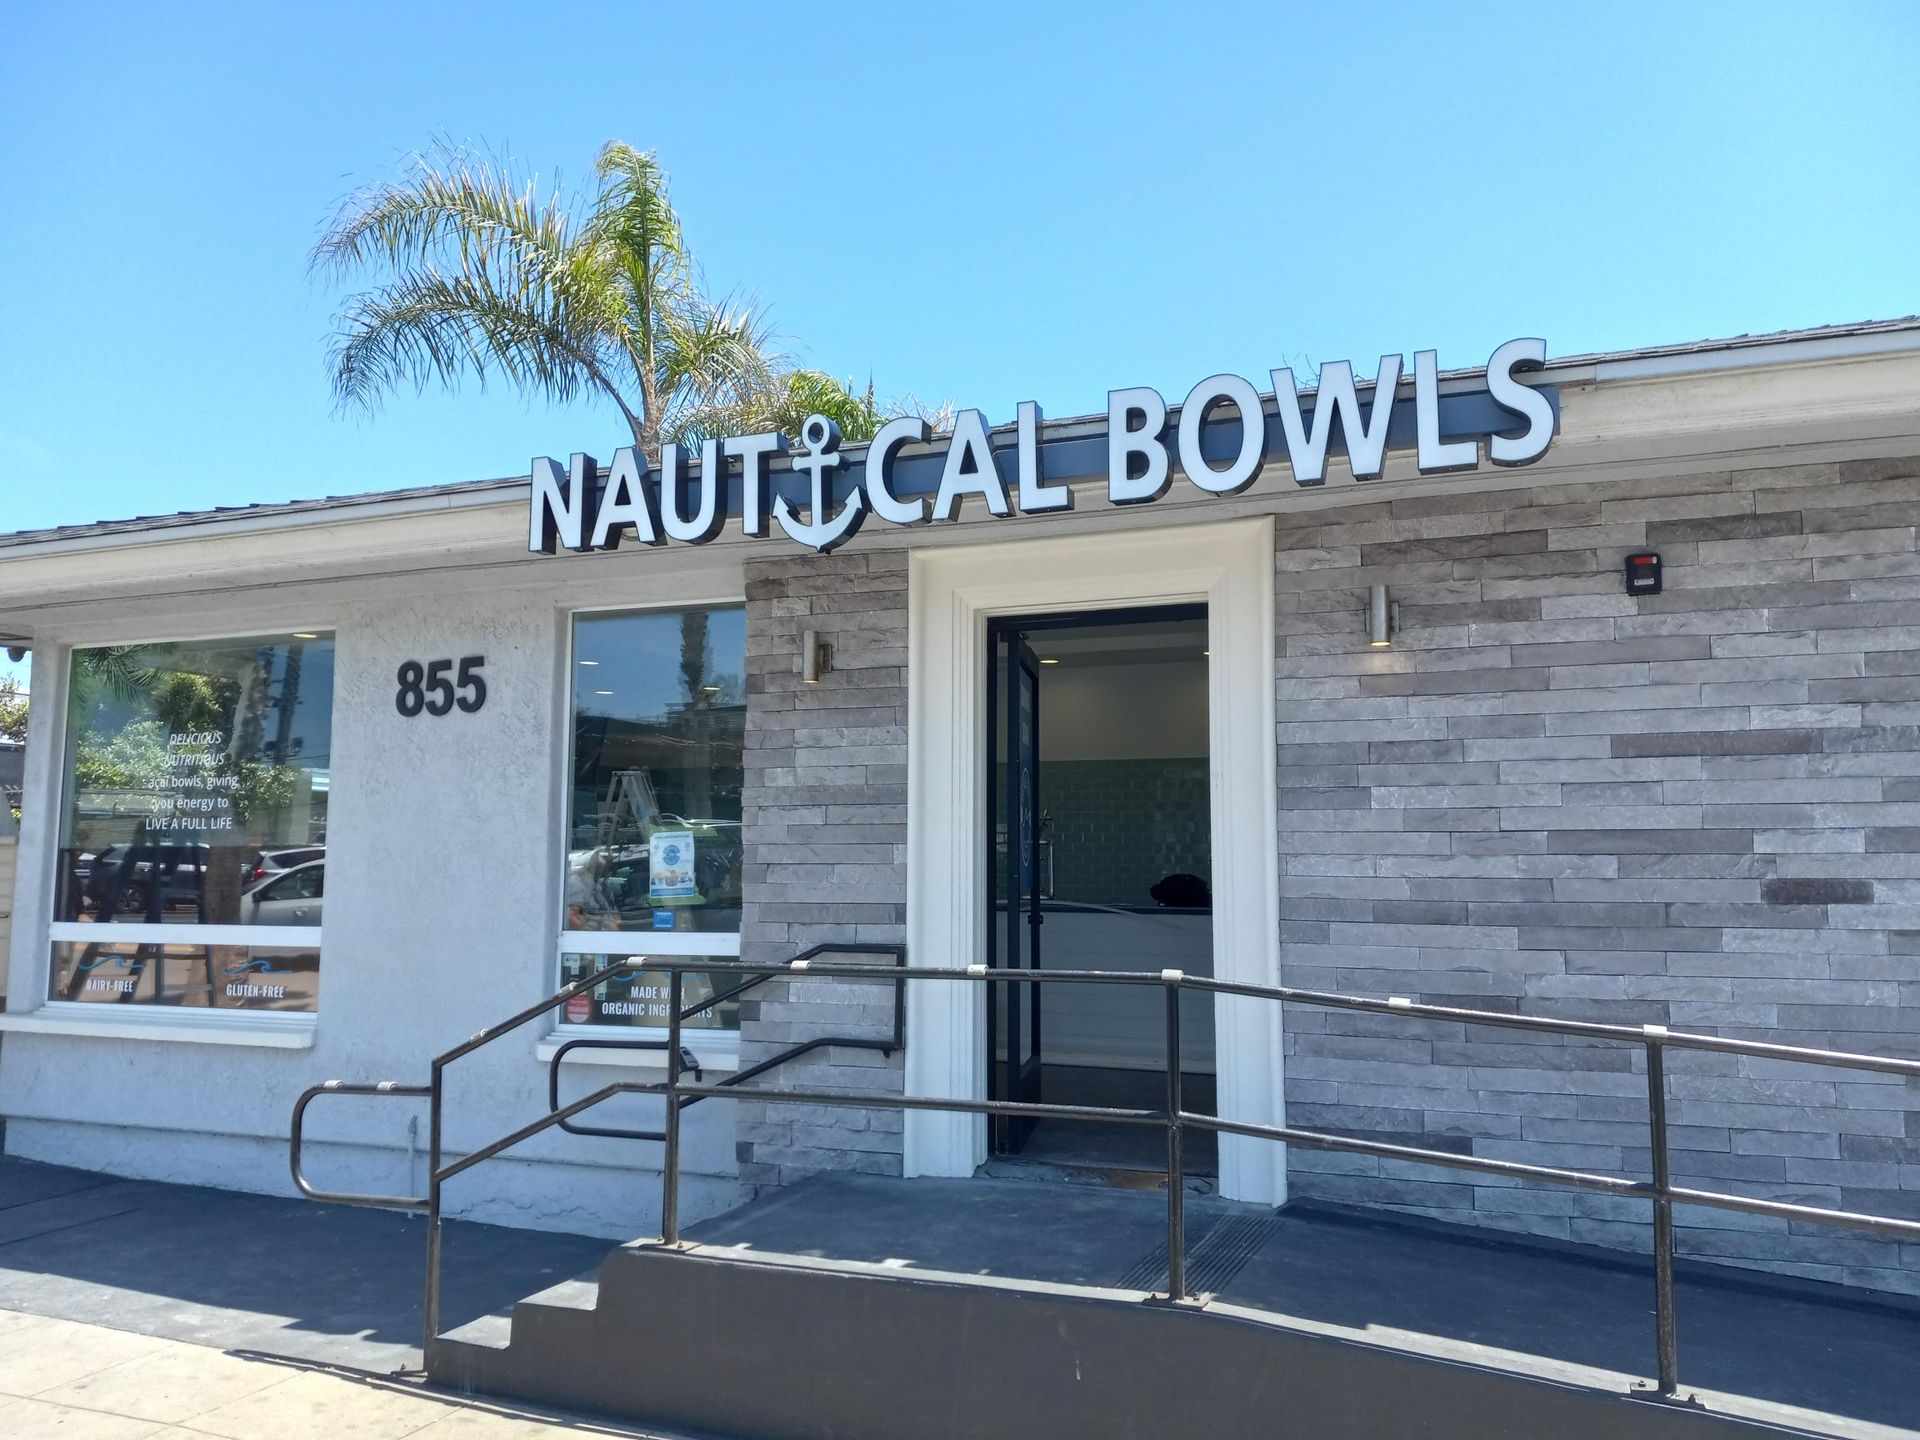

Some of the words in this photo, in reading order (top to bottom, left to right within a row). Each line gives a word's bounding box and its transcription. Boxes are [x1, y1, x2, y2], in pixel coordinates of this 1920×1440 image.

[1108, 337, 1556, 506] BOWLS
[395, 655, 487, 717] 855
[169, 731, 223, 745] DELICIOUS
[164, 752, 225, 767] NUTRITIOUS
[171, 775, 204, 788] bowls,
[206, 774, 239, 790] giving
[152, 799, 174, 812] you
[177, 798, 215, 811] energy
[217, 797, 229, 808] to
[145, 817, 169, 830] LIVE
[170, 817, 179, 830] A
[181, 817, 207, 830] FULL
[210, 817, 232, 830] LIFE
[86, 979, 133, 993] DAIRY-FREE
[226, 984, 285, 998] GLUTEN-FREE
[631, 986, 657, 999] MADE
[661, 987, 685, 1000] WIH
[602, 1002, 645, 1016] ORGANIC
